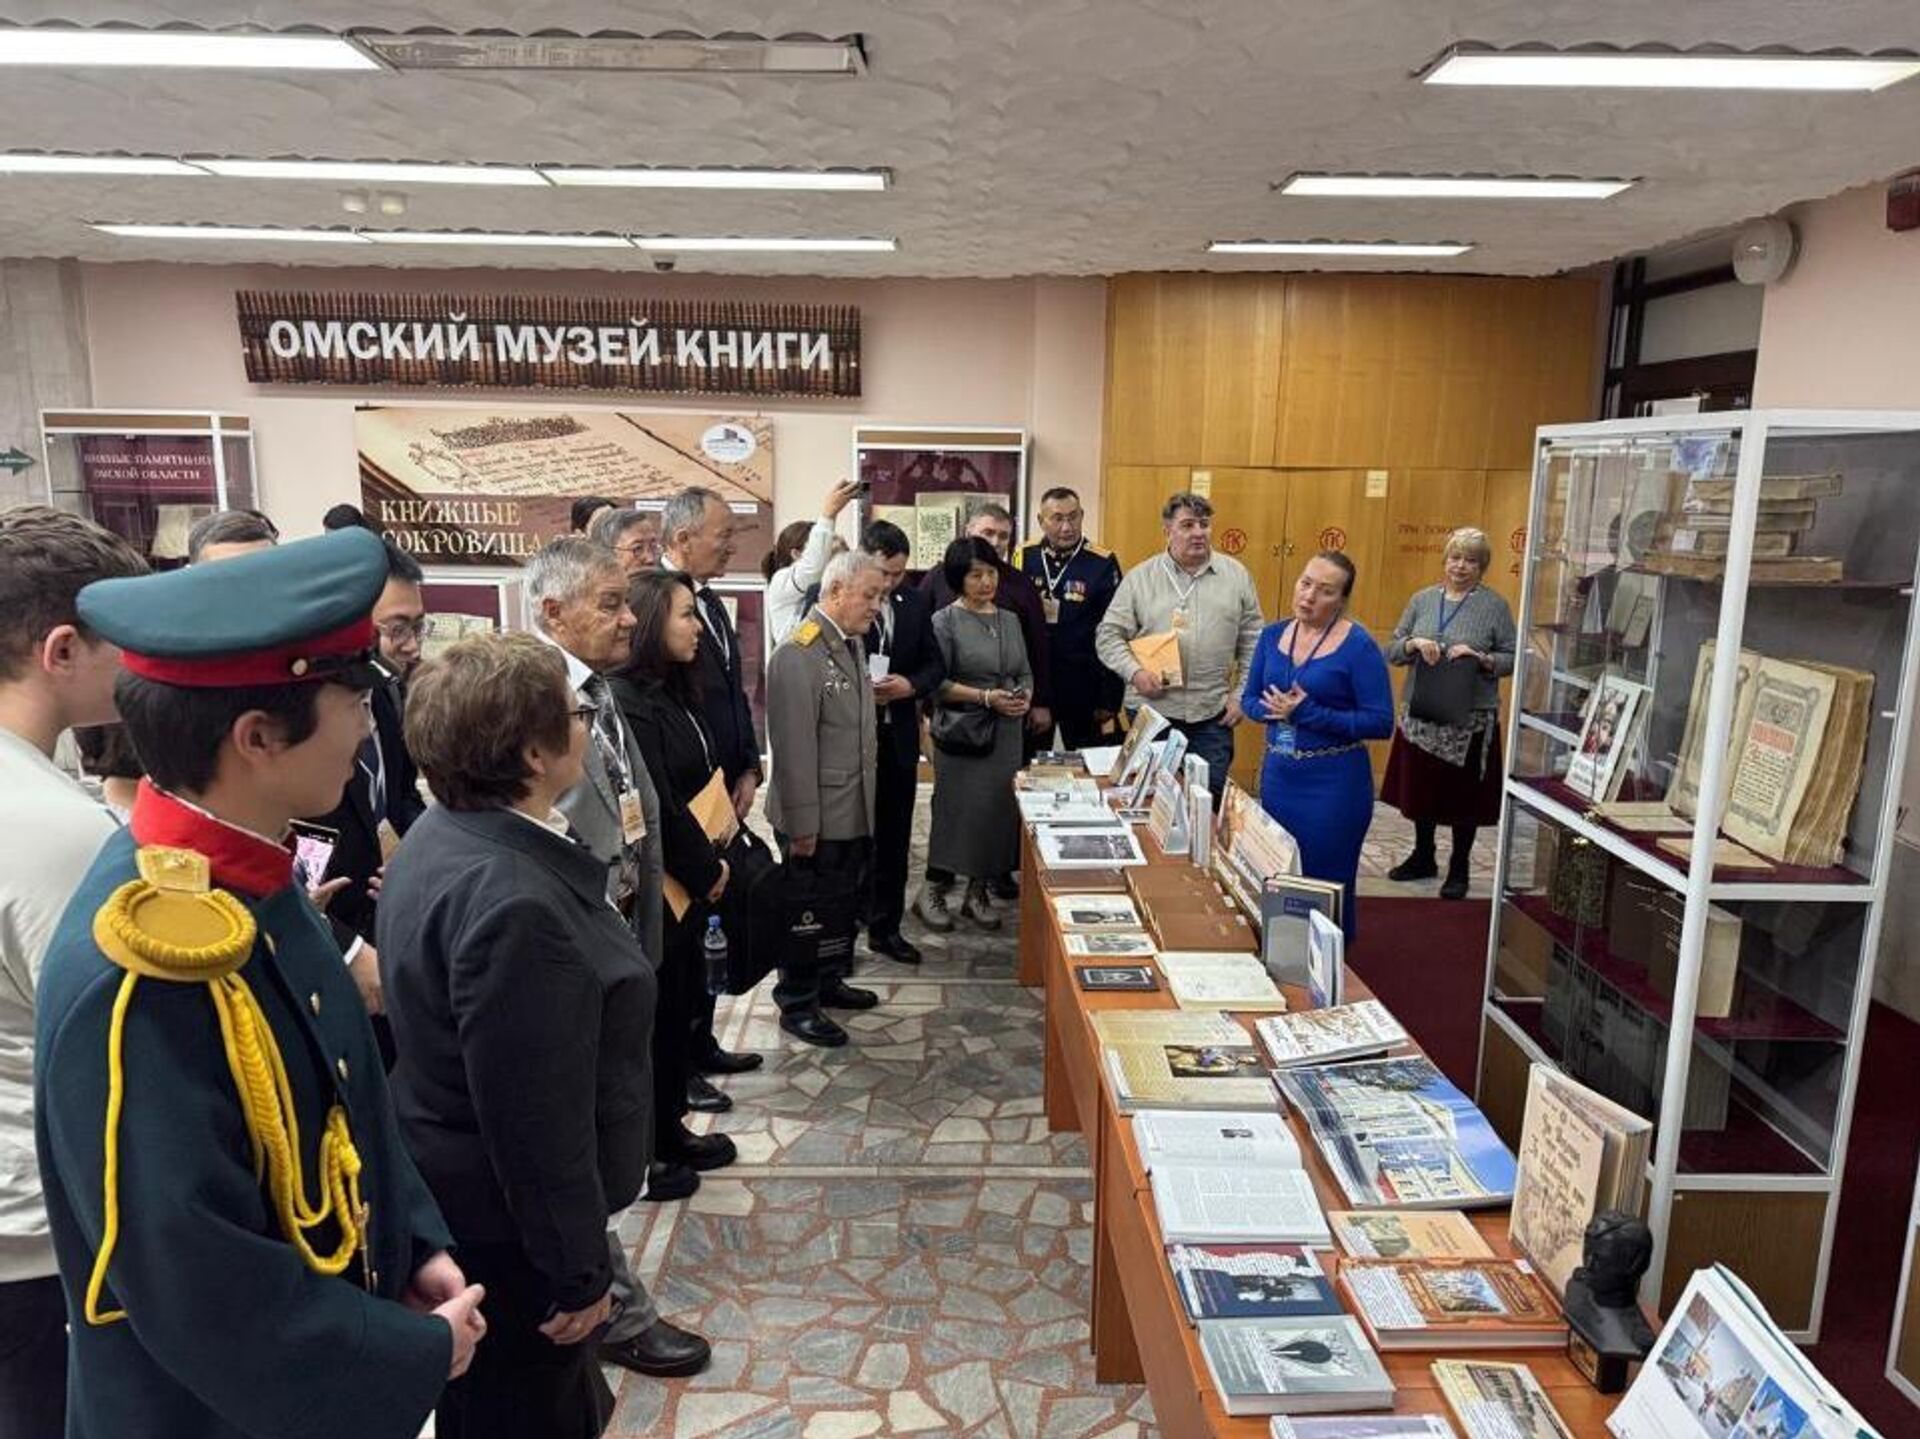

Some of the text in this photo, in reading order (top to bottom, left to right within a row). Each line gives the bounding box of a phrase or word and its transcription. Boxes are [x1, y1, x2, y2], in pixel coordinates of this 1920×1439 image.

[267, 312, 831, 370] ОМСКИЙ МУЗЕЙ КНИГИ
[141, 469, 201, 481] ОБЛАСТИ
[379, 499, 522, 526] КНИЖНЫЕ
